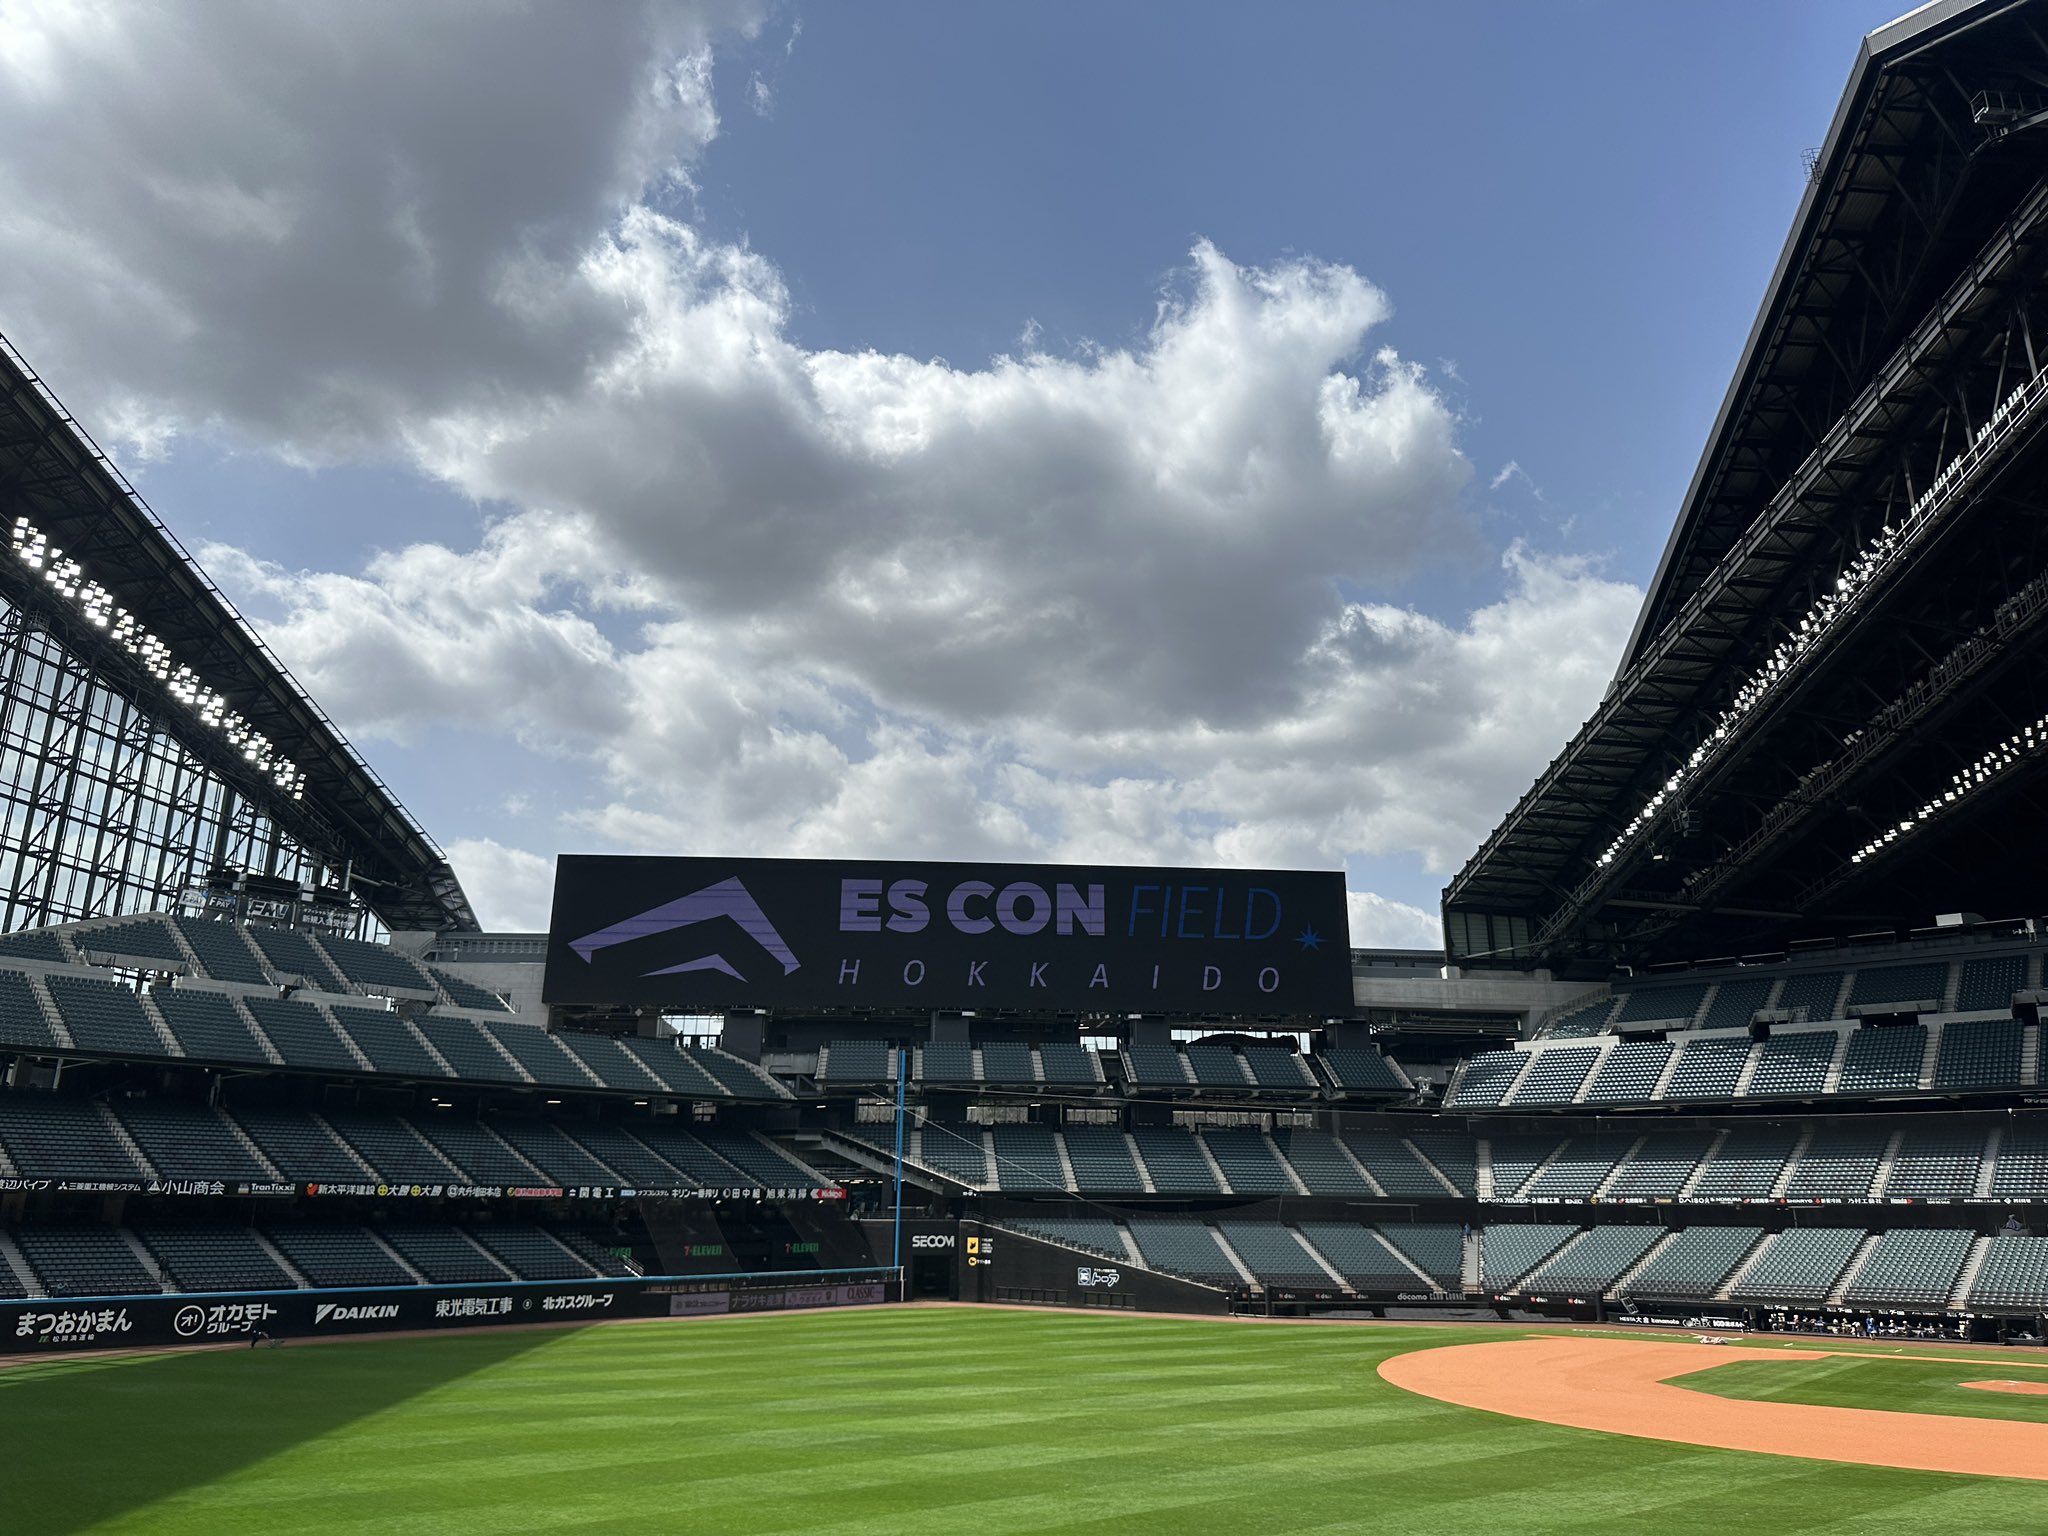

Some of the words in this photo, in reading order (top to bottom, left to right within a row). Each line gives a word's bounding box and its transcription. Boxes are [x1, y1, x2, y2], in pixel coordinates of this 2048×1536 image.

[216, 900, 230, 909] PAY
[839, 879, 931, 933] ES
[946, 880, 1105, 936] CON
[1128, 885, 1282, 940] FIELD
[838, 958, 1280, 993] HOKKAIDO
[162, 1180, 225, 1195] 小山商会
[251, 1183, 296, 1191] TranTixxii
[317, 1184, 376, 1196] 新太平洋建設
[387, 1184, 411, 1196] 大勝
[420, 1184, 443, 1196] 大勝
[671, 1188, 719, 1199] キリン一番搾り
[731, 1188, 761, 1199] 田中組
[912, 1235, 955, 1247] SECOM
[684, 1245, 722, 1256] 7-ELEVEN
[785, 1243, 819, 1254] 7-ELEVEN
[847, 1287, 875, 1300] CLASSIC
[1397, 1292, 1427, 1300] docomo
[435, 1297, 512, 1317] 東光電気工事
[542, 1294, 614, 1310] 北ガスグループ
[208, 1303, 277, 1322] オカモト
[332, 1305, 399, 1321] DAIKIN
[16, 1308, 132, 1336] まつおかまん
[207, 1320, 253, 1334] グループ
